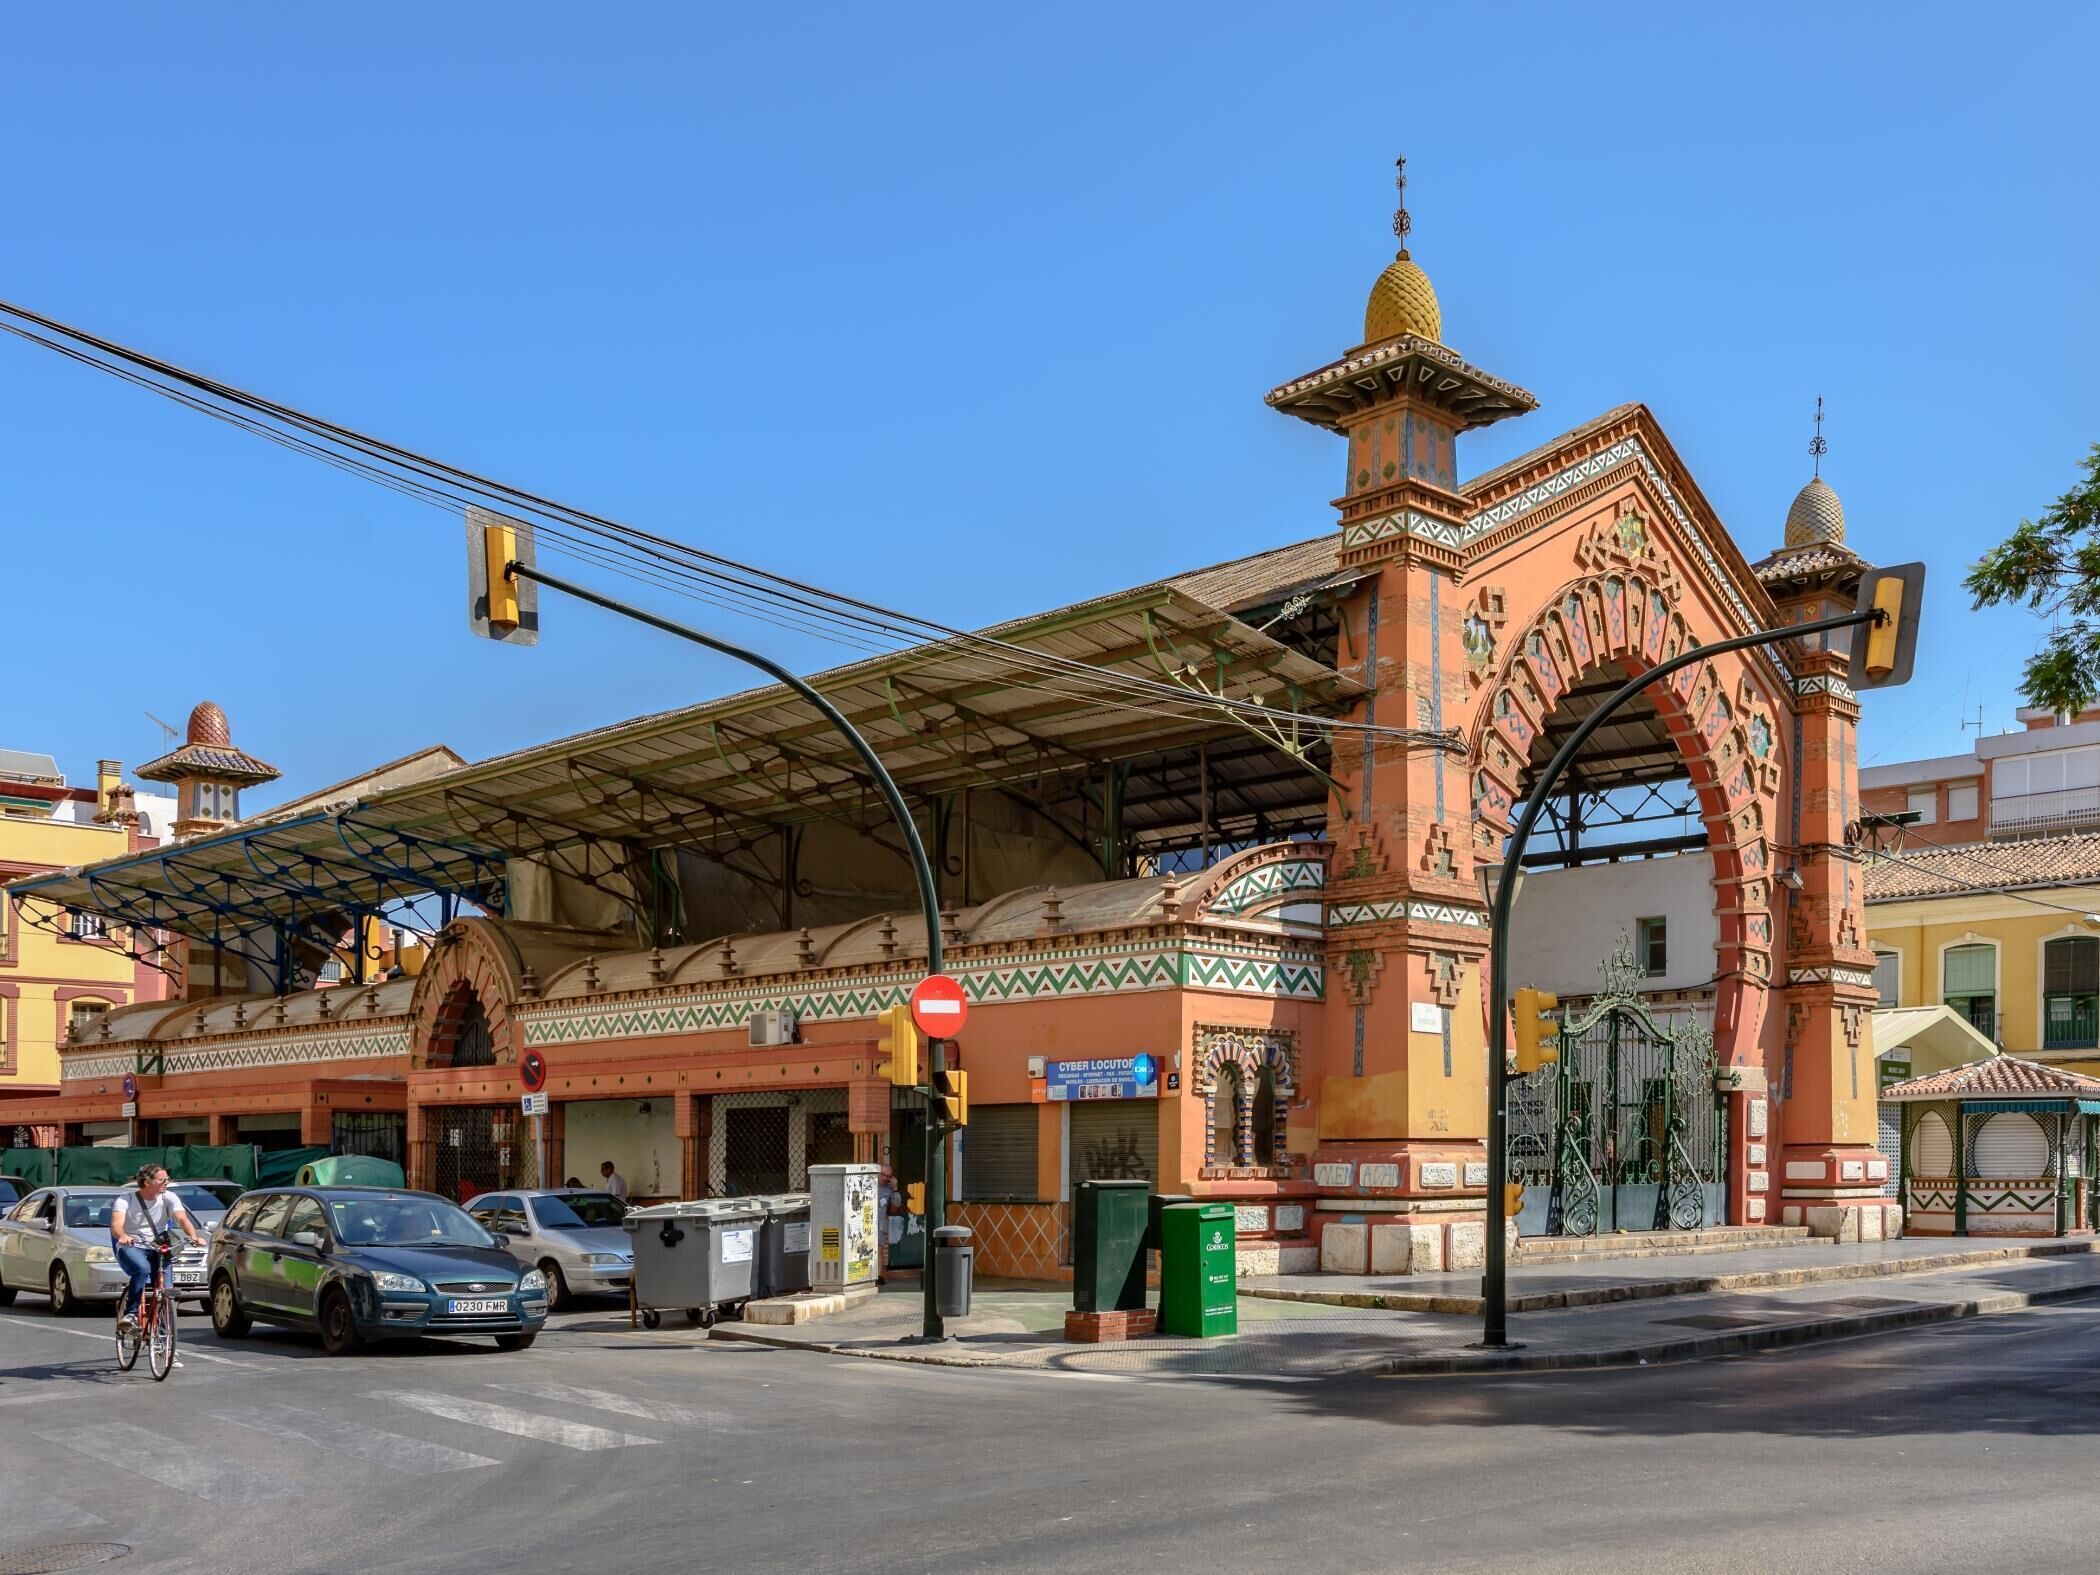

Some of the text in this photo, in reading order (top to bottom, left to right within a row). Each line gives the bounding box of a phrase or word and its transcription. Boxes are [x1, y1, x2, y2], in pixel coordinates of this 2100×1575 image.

[1059, 1061, 1089, 1071] CYBER
[456, 1301, 506, 1312] 0230 FMR
